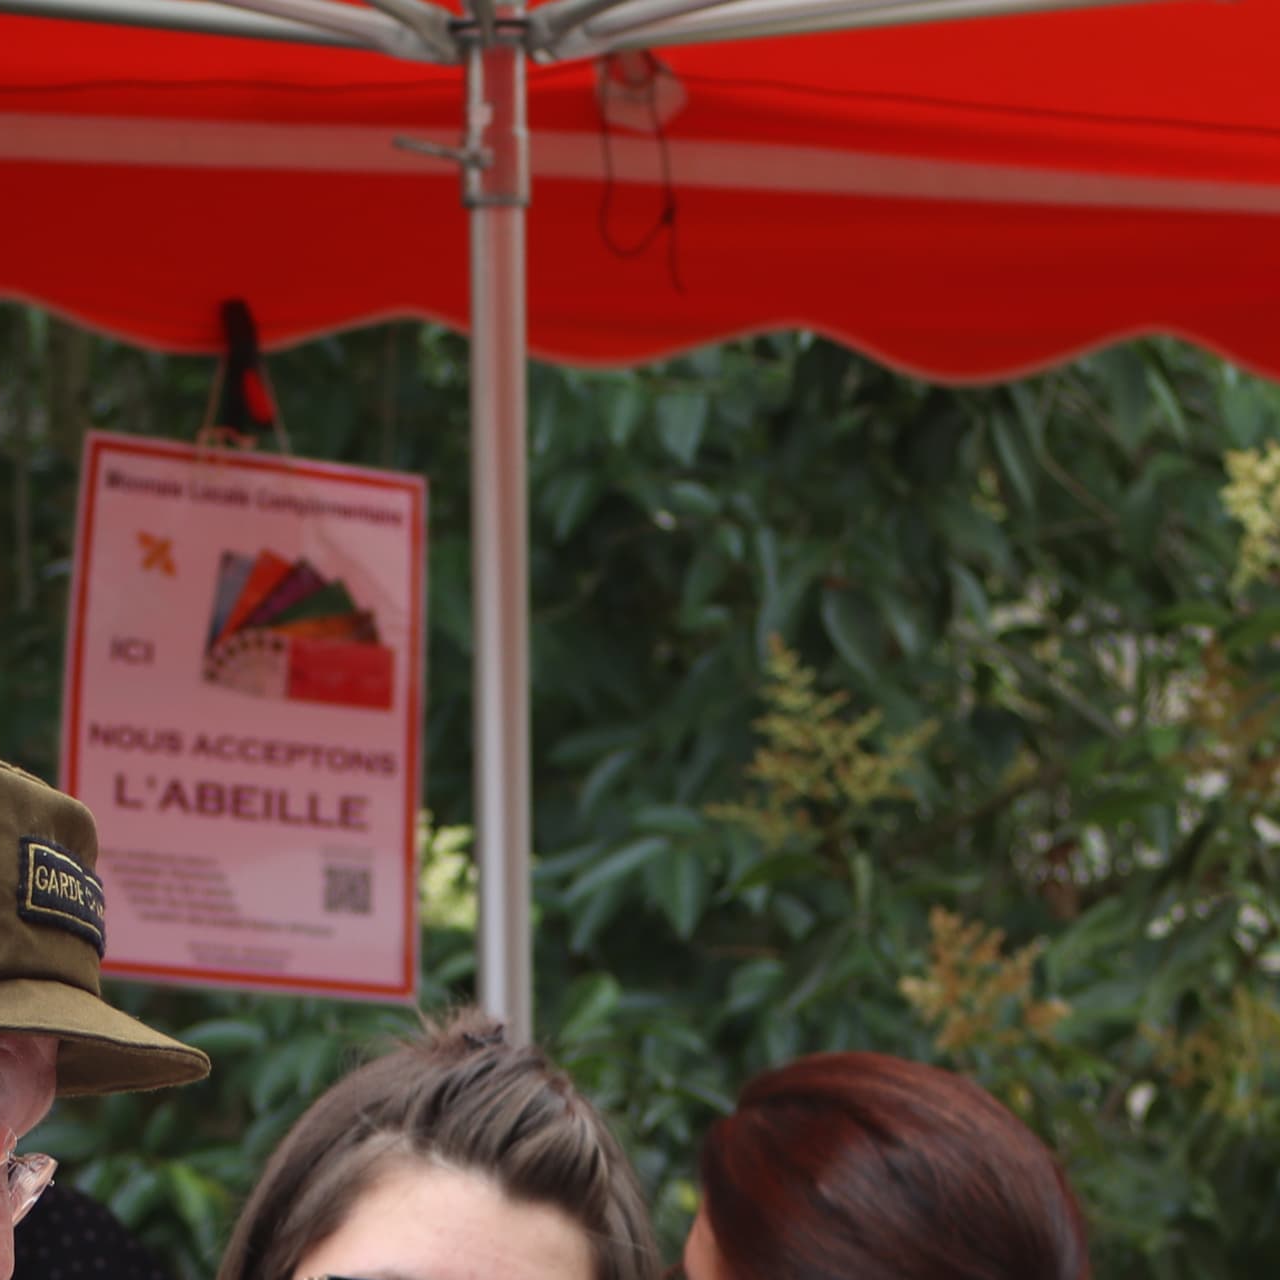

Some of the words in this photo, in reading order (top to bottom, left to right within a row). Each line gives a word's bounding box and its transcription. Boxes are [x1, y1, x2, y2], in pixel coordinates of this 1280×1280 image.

[111, 639, 154, 666] ICI
[89, 723, 182, 754] NOUS
[193, 732, 397, 776] ACCEPTONS
[114, 773, 370, 832] L'ABEILLE
[35, 865, 84, 905] GARDE
